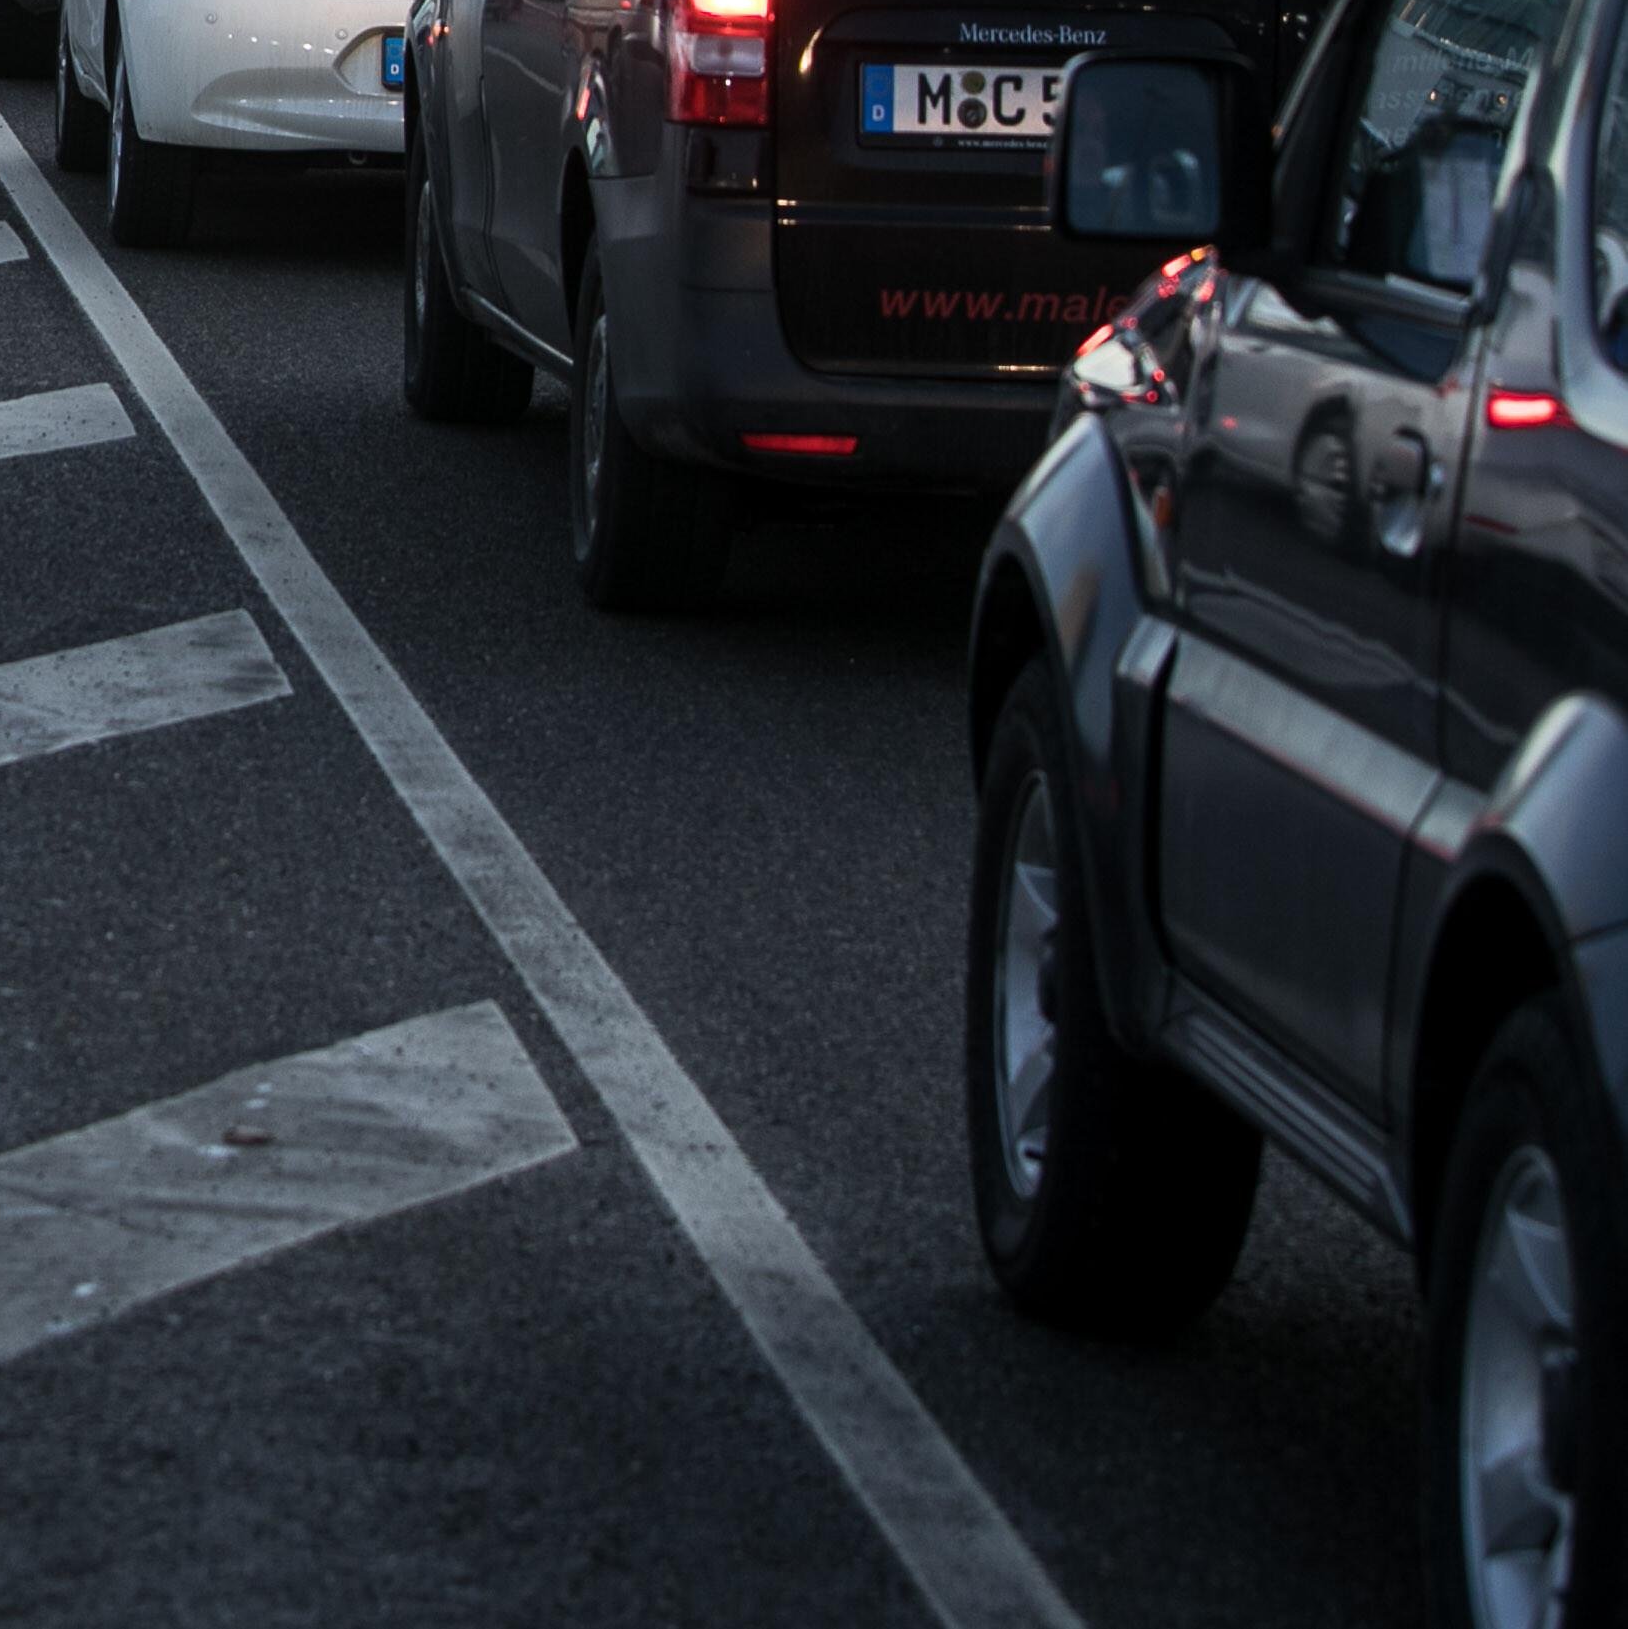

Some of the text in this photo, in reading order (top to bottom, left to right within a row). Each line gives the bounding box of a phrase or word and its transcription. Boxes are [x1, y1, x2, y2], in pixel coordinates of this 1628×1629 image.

[959, 23, 1107, 45] Mercedes-Benz
[390, 63, 400, 74] D
[917, 73, 952, 125] M
[993, 75, 1026, 126] C
[872, 105, 885, 122] D
